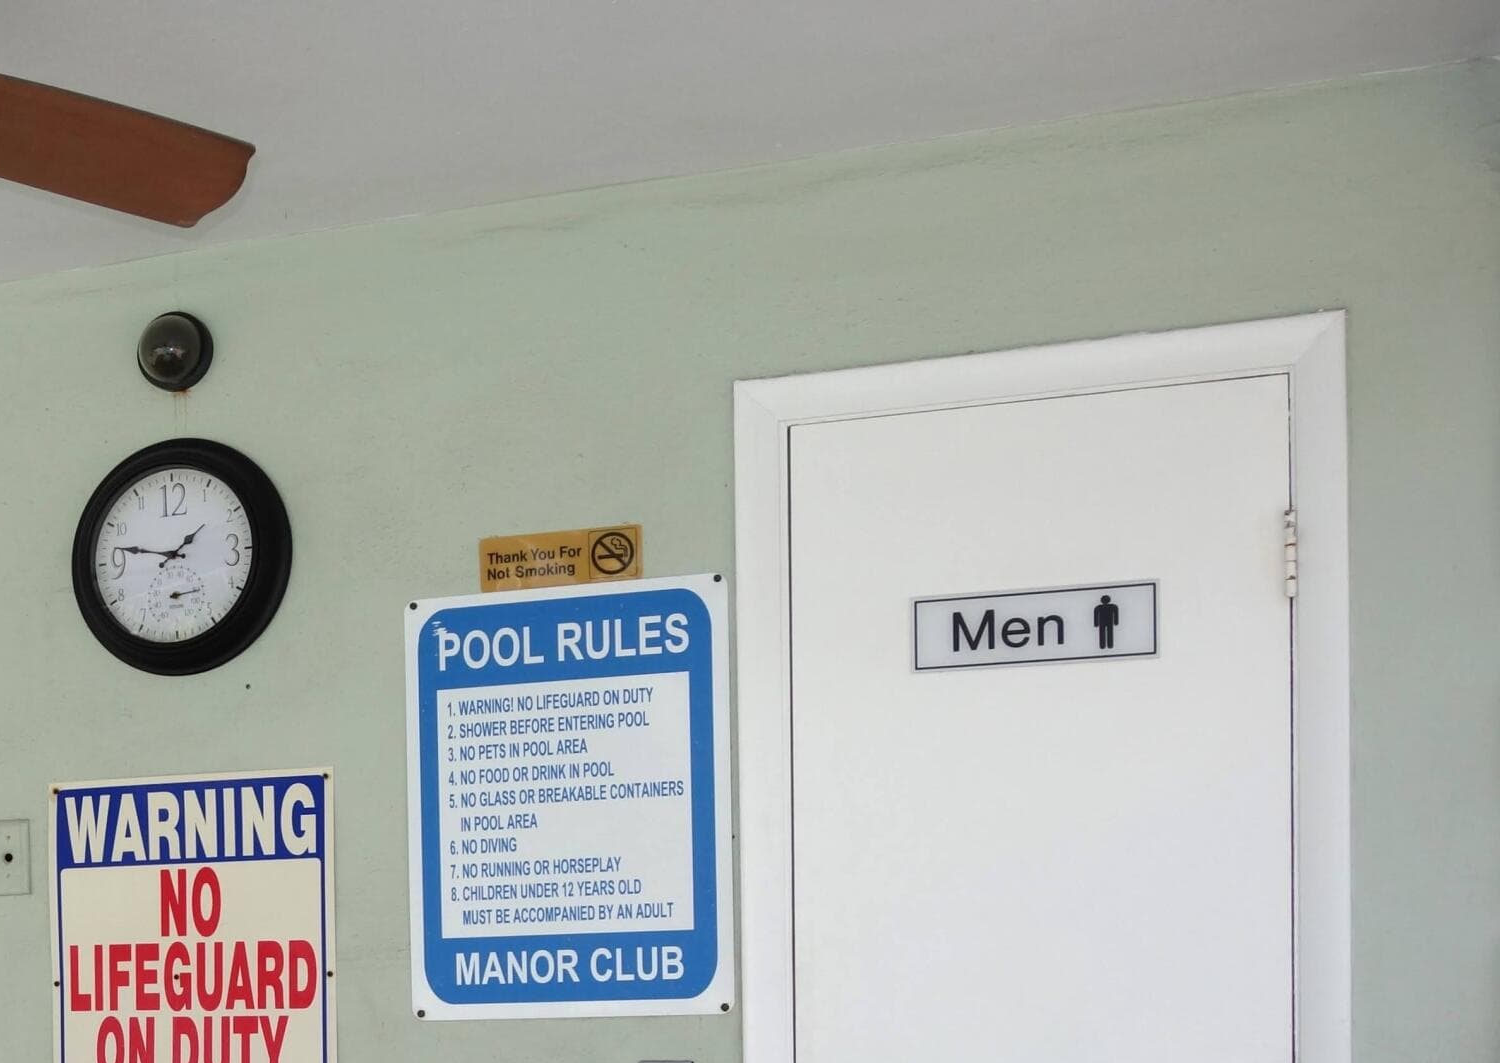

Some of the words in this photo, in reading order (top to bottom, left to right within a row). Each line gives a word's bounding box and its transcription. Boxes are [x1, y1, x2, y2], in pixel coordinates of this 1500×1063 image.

[160, 483, 187, 518] 12
[226, 508, 233, 522] 2
[116, 522, 127, 537] 10
[225, 533, 240, 566] 3
[487, 550, 528, 565] Thank
[531, 548, 555, 561] You
[559, 546, 582, 558] For
[112, 547, 126, 580] 9
[487, 568, 510, 580] Not
[515, 563, 576, 578] Smoking
[118, 588, 125, 601] 8
[227, 576, 234, 589] 4
[140, 607, 147, 622] 7
[206, 601, 212, 616] 5
[438, 626, 545, 671] POOL
[557, 613, 689, 662] RULES
[953, 609, 1064, 652] Men
[447, 702, 456, 717] 1.
[458, 697, 514, 716] WARNING!
[517, 696, 533, 711] NO
[536, 691, 600, 710] LIFEGUARD
[603, 689, 619, 705] ON
[623, 687, 653, 704] DUTY
[448, 725, 457, 739] 2.
[459, 720, 507, 738] SHOWER
[510, 717, 555, 735] BEFORE
[558, 714, 614, 732] ENTERING
[618, 711, 649, 728] POOL
[448, 747, 457, 762] 3.
[460, 746, 475, 762] NO
[479, 743, 506, 760] PETS
[509, 742, 520, 757] IN
[523, 740, 553, 757] POOL
[556, 738, 588, 755] AREA
[448, 771, 458, 786] 4.
[460, 769, 476, 785] NO
[479, 767, 510, 784] FOOD
[512, 766, 529, 782] OR
[532, 764, 566, 781] DRINK
[569, 763, 580, 779] IN
[583, 761, 615, 778] POOL
[449, 794, 458, 809] 5.
[461, 792, 477, 808] NO
[479, 790, 516, 807] GLASS
[519, 789, 535, 805] OR
[538, 785, 607, 804] BREAKABLE
[609, 780, 684, 799] CONTAINERS
[64, 782, 317, 864] WARNING
[461, 817, 471, 832] IN
[474, 815, 504, 831] POOL
[507, 813, 538, 829] AREA
[450, 841, 459, 855] 6.
[462, 839, 477, 855] NO
[480, 837, 517, 853] DIVING
[450, 864, 459, 879] 7.
[462, 863, 478, 879] NO
[481, 860, 531, 878] RUNNING
[534, 859, 550, 875] OR
[553, 856, 621, 875] HORSEPLAY
[159, 867, 221, 937] NO
[451, 887, 460, 901] 8.
[462, 884, 517, 901] CHILDREN
[520, 882, 558, 899] UNDER
[562, 881, 574, 897] 12
[576, 880, 615, 897] YEARS
[618, 879, 641, 895] OLD
[463, 909, 492, 925] MUST
[496, 908, 510, 924] BE
[513, 905, 595, 924] ACCOMPANIED
[598, 904, 613, 920] BY
[616, 903, 633, 919] AN
[635, 902, 674, 919] ADULT
[70, 940, 317, 1012] LIFEGUARD
[455, 949, 580, 986] MANOR
[590, 946, 684, 983] CLUB
